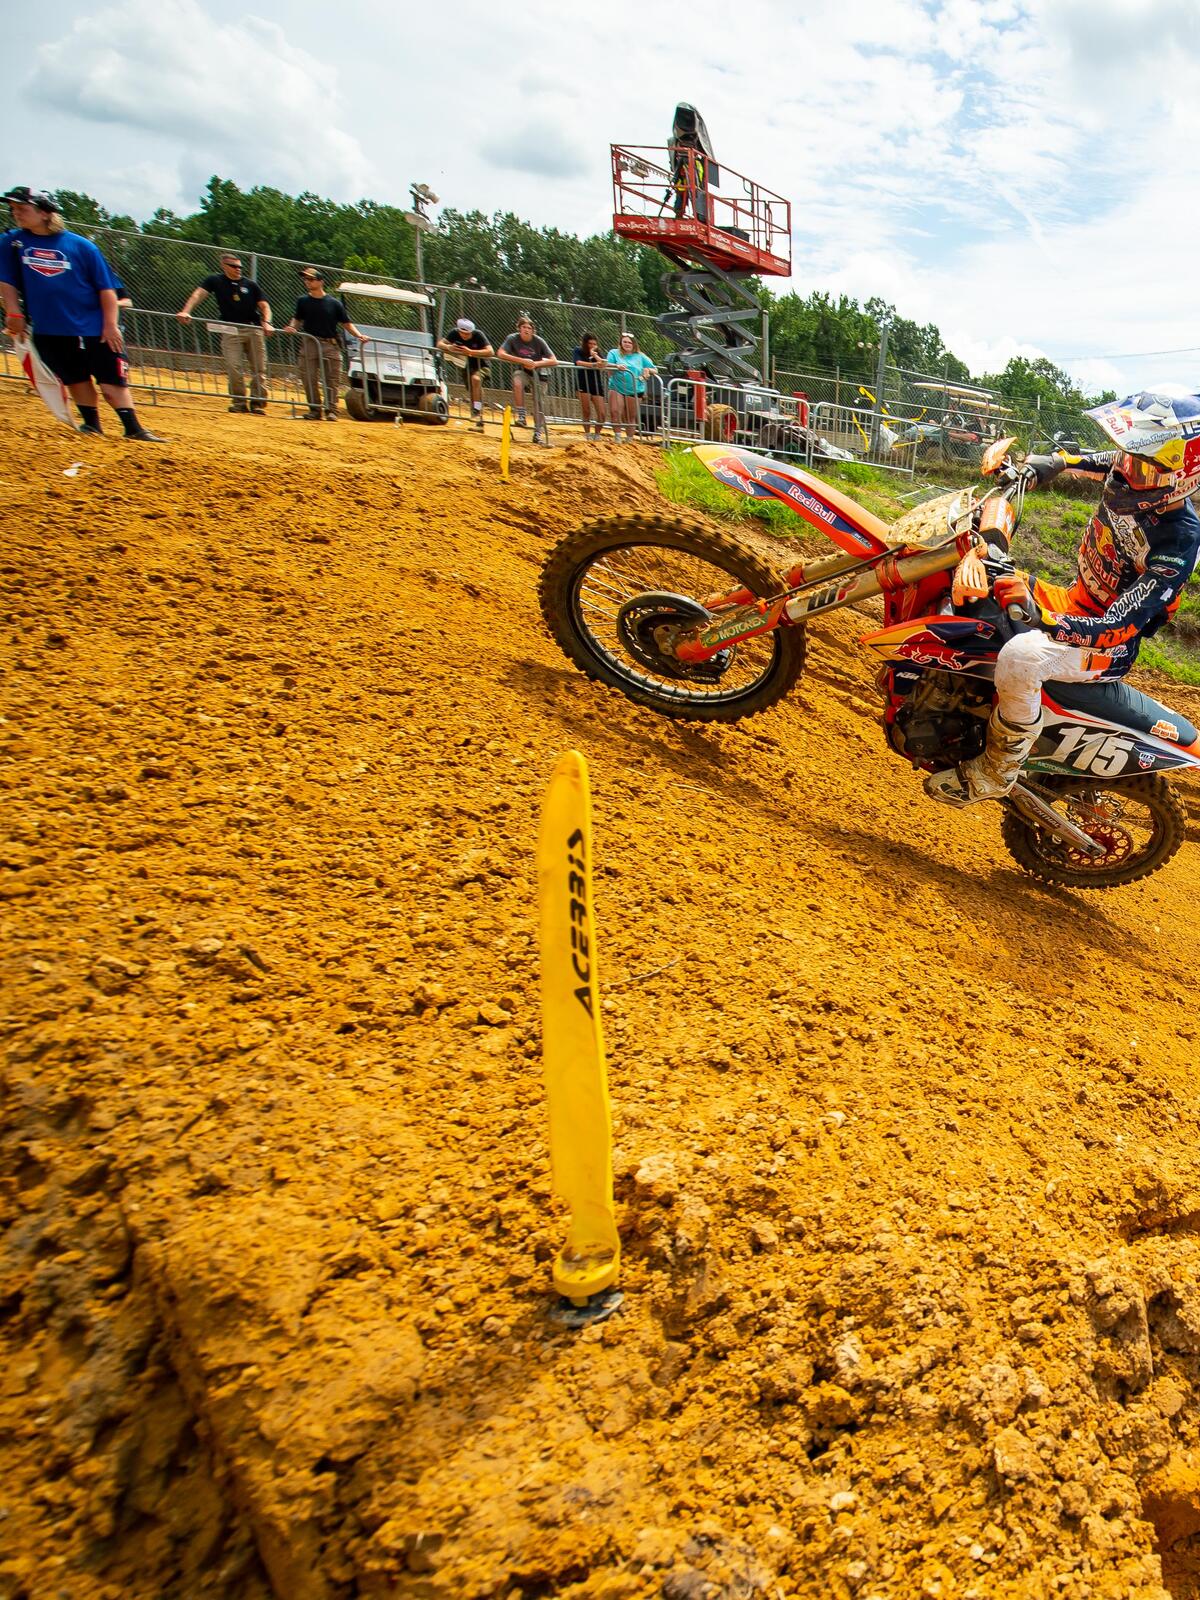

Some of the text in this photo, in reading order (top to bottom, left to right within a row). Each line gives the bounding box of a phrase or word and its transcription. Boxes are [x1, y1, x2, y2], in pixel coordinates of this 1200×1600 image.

[718, 615, 766, 640] MOTOREX
[1095, 623, 1139, 649] KTM
[895, 671, 920, 681] KTM
[1051, 726, 1136, 777] 115
[567, 827, 594, 1020] ACERBIS
